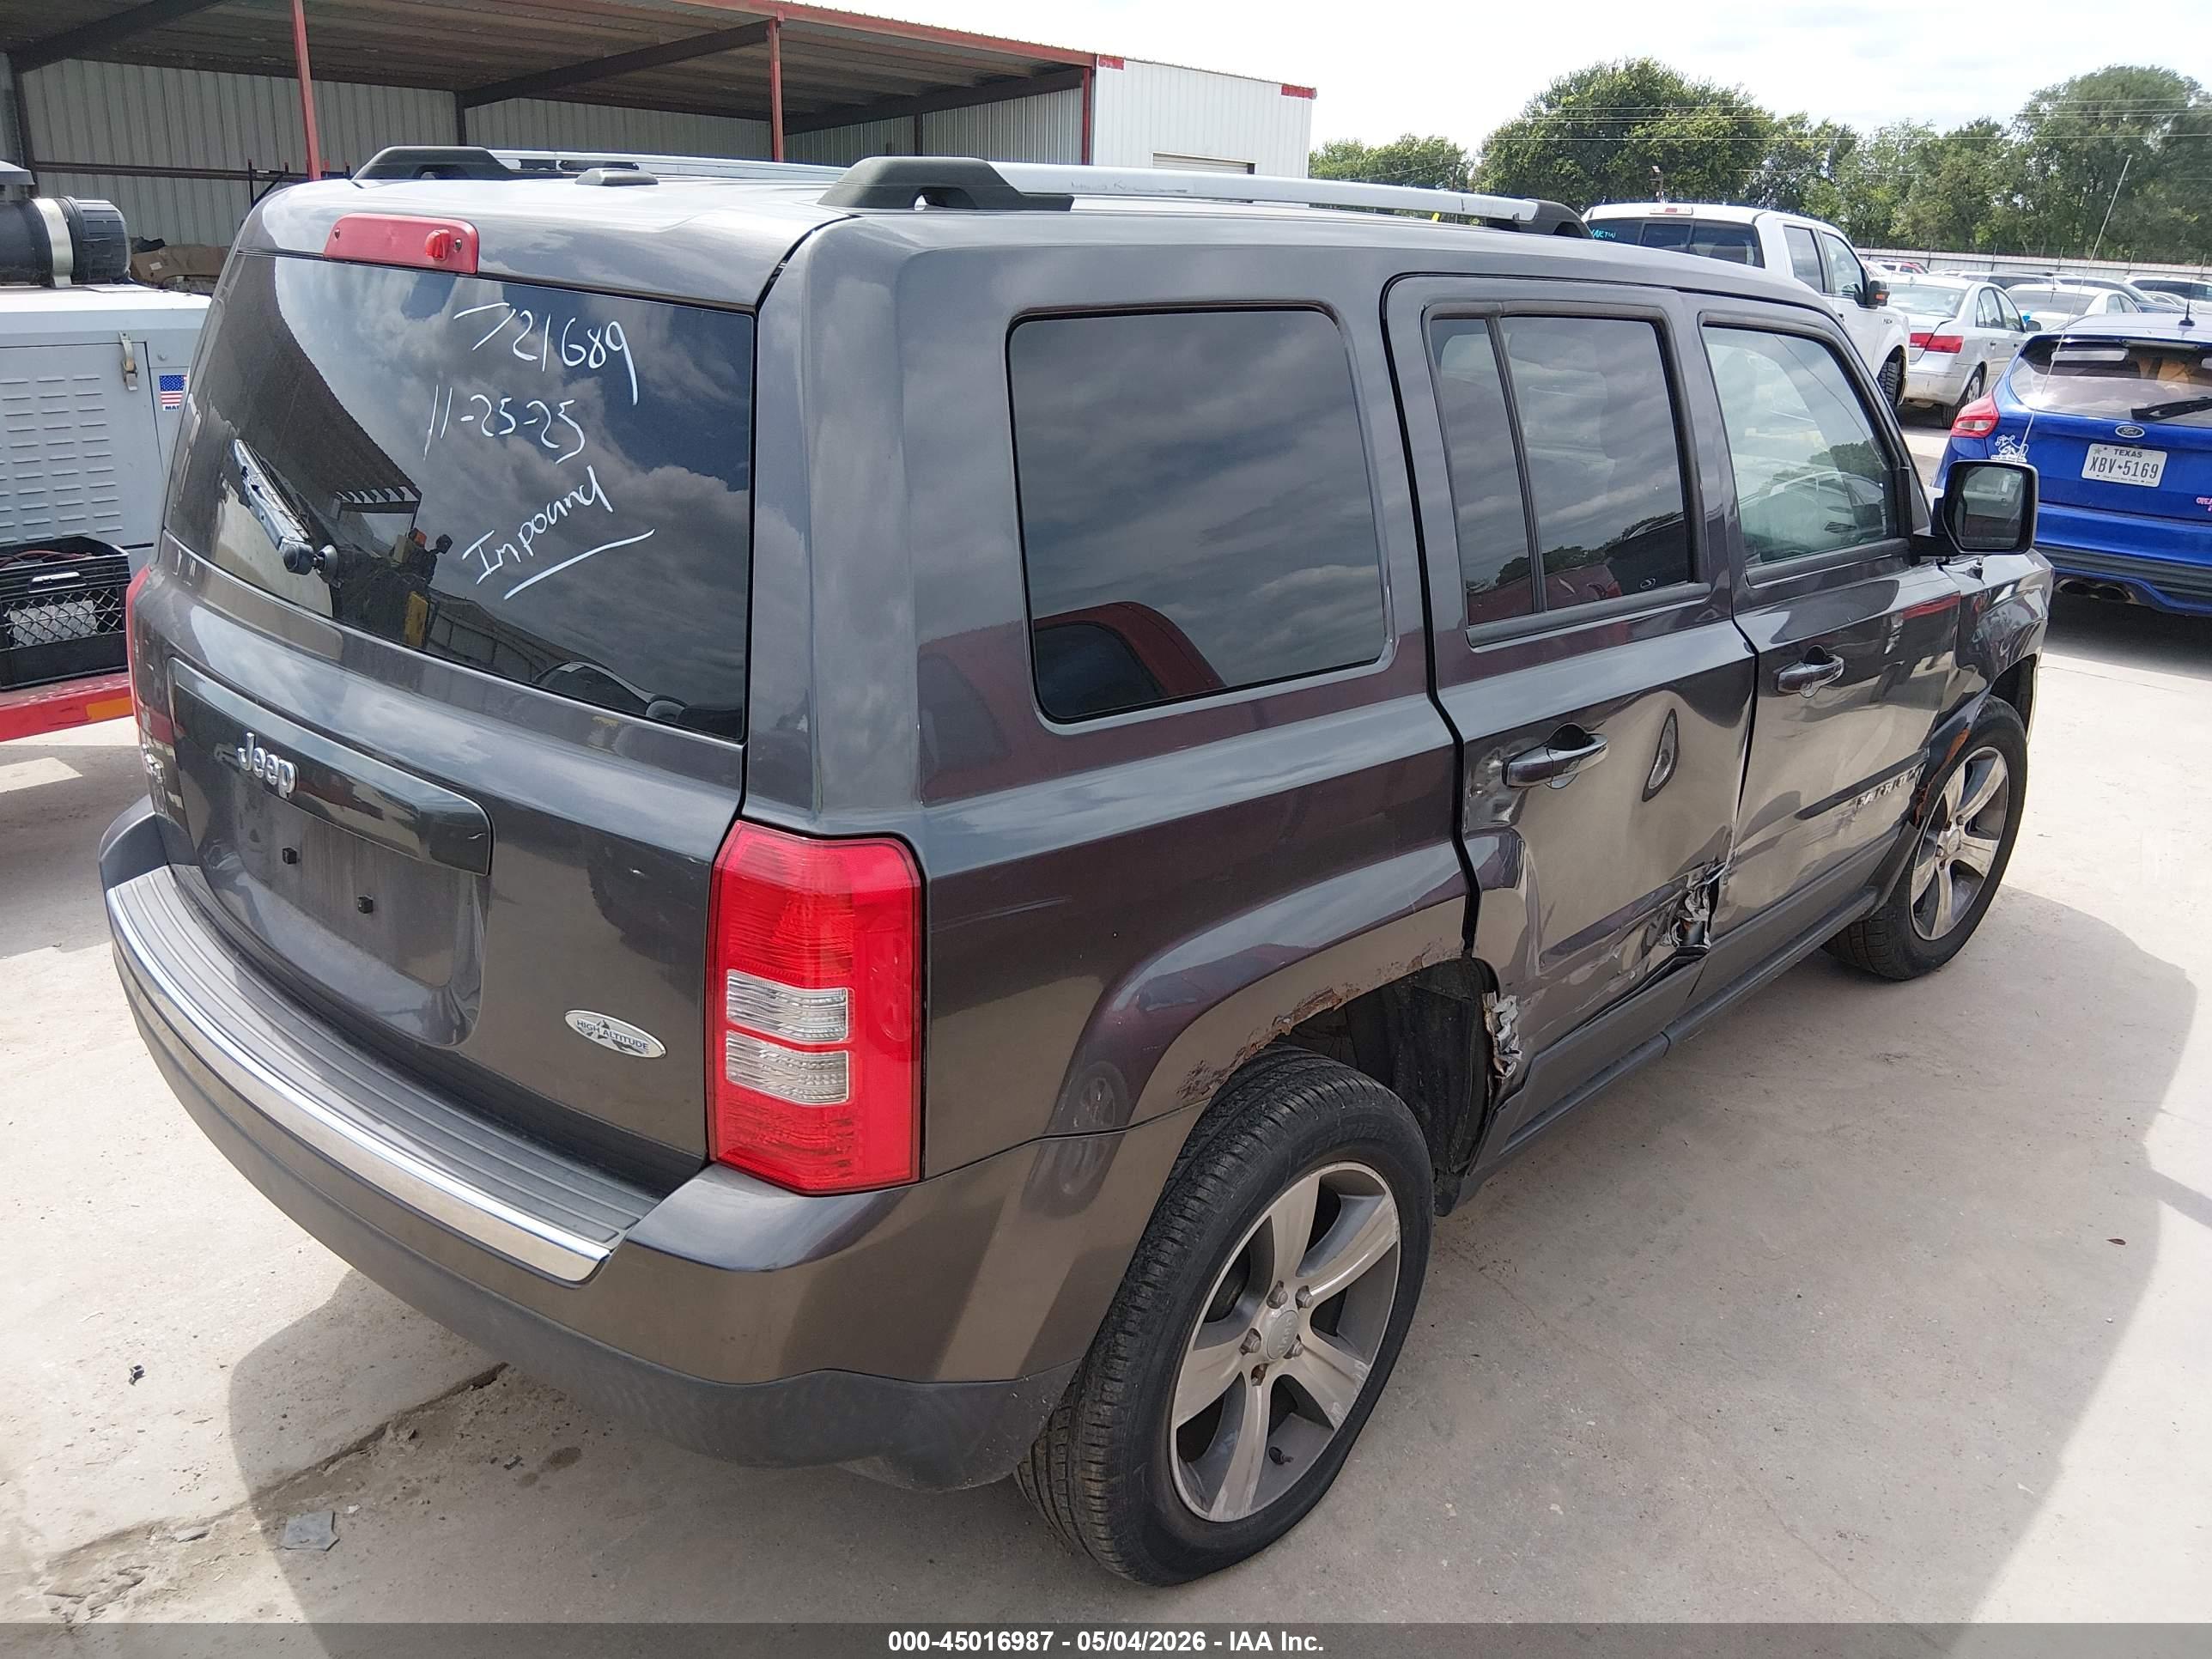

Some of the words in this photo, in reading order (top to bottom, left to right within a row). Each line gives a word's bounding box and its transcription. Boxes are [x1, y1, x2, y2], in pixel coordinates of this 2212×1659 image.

[453, 301, 638, 406] 721689
[423, 384, 586, 465] 11-25-25
[2114, 448, 2143, 459] TEXAS
[237, 732, 296, 799] Jeep
[576, 1019, 600, 1033] HIGH
[603, 1030, 649, 1051] ALTITUDE
